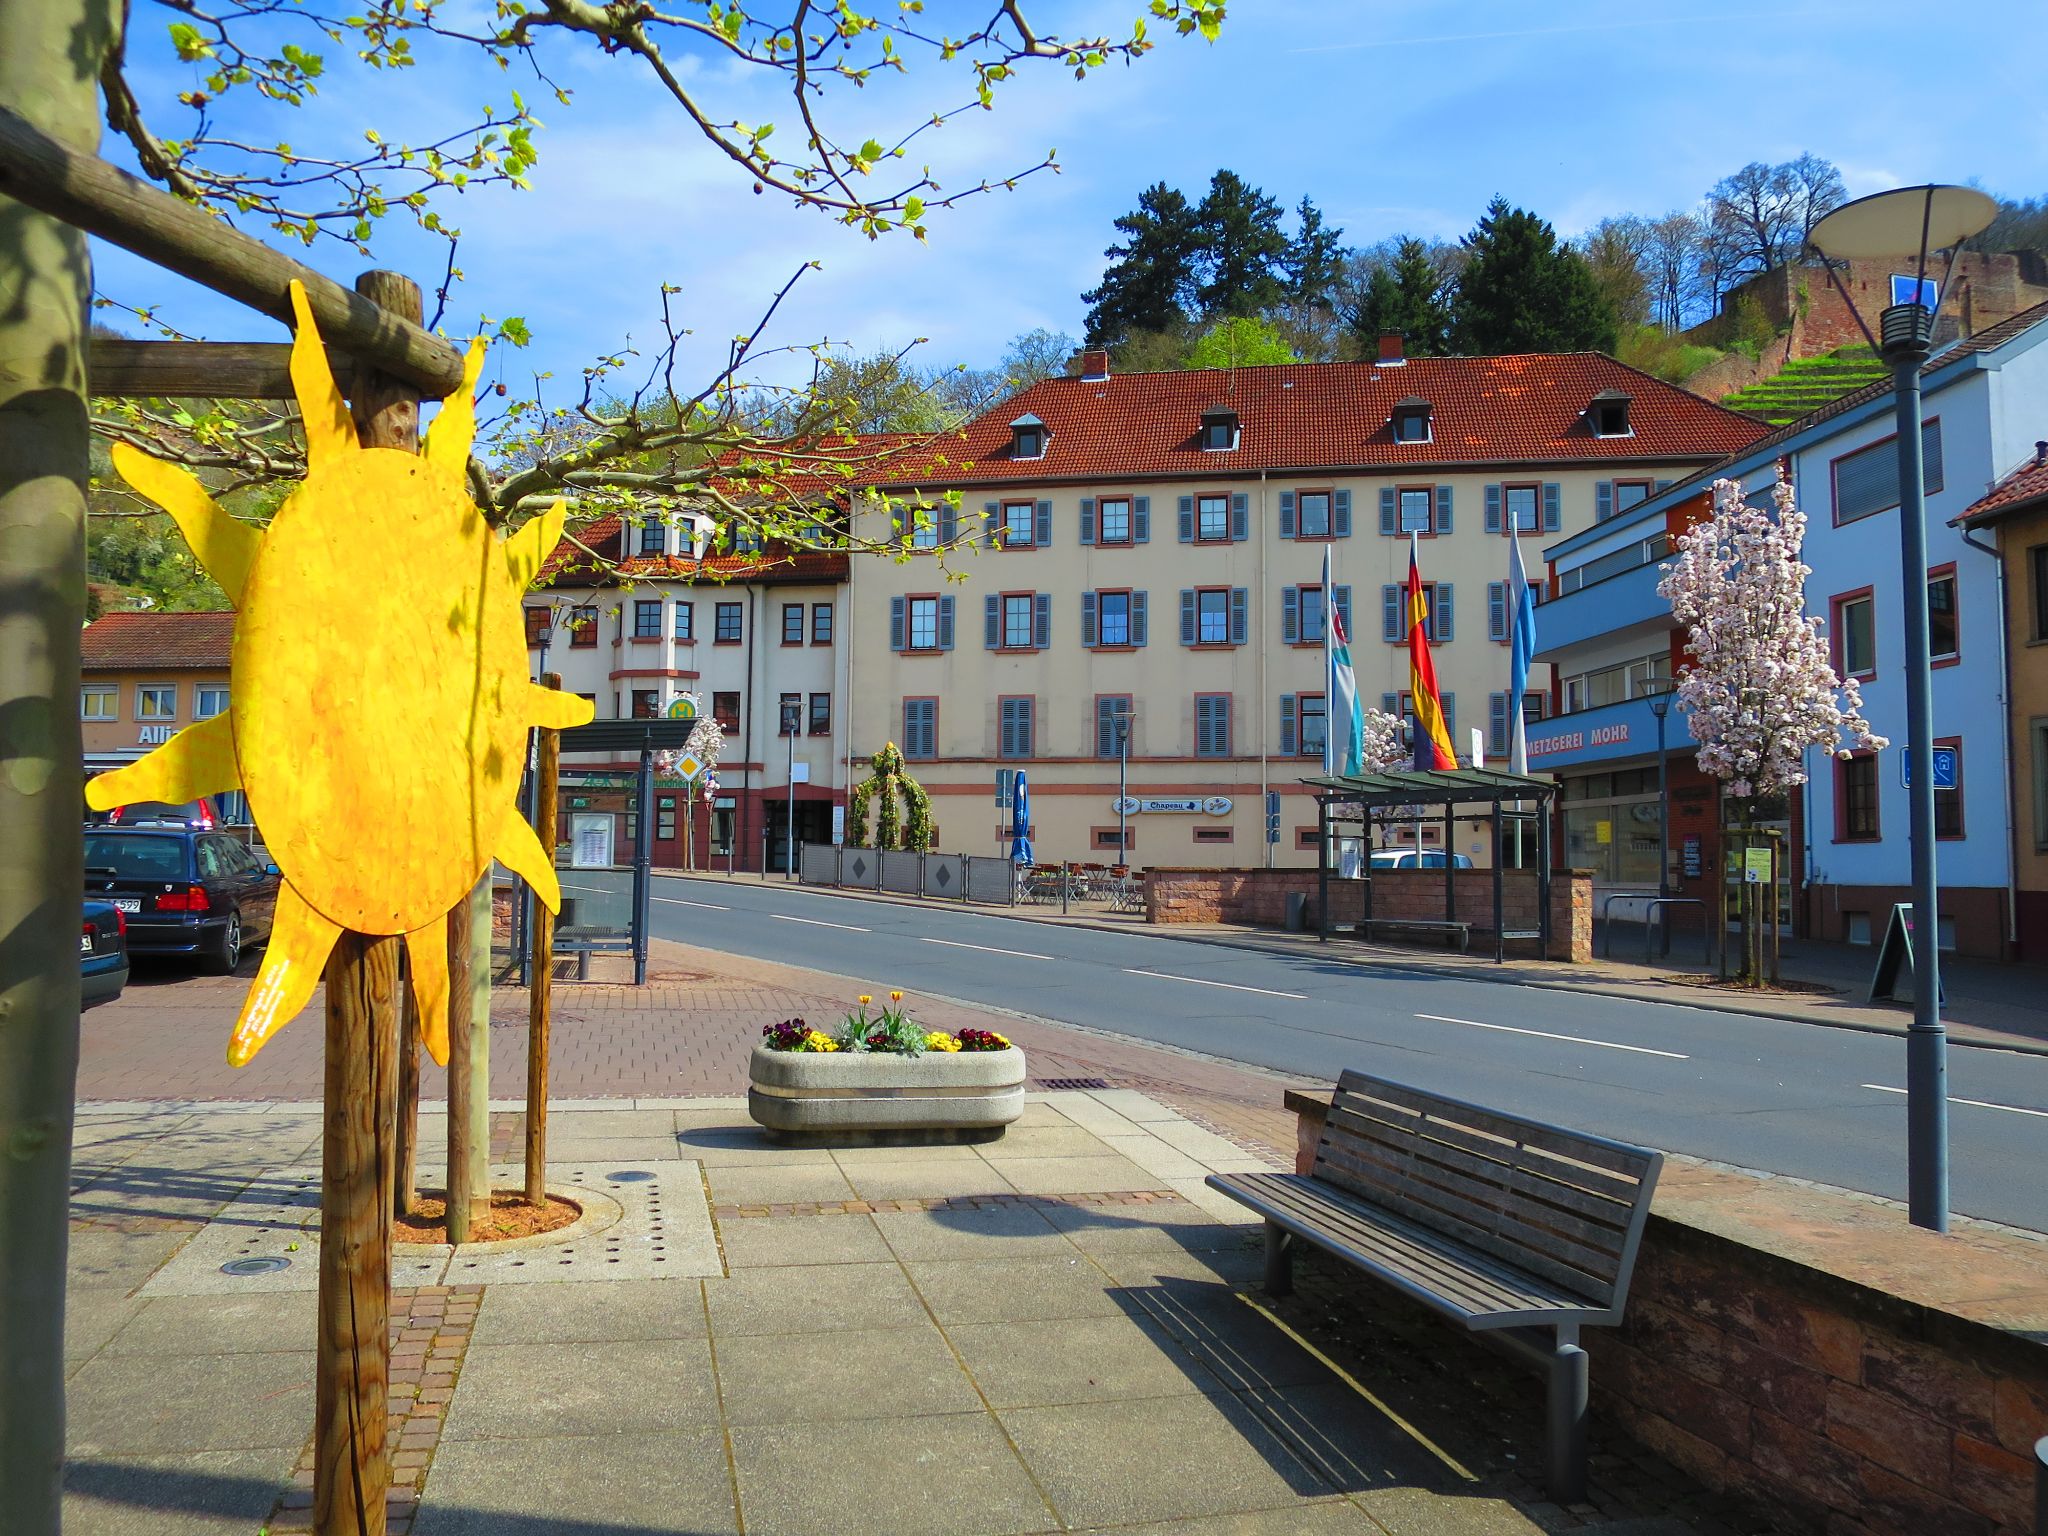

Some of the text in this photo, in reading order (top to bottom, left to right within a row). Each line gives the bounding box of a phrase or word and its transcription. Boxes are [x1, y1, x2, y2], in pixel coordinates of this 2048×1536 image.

[138, 725, 180, 744] Alli
[1526, 724, 1629, 757] METZGEREI MOHR
[1150, 801, 1183, 810] Chapeau
